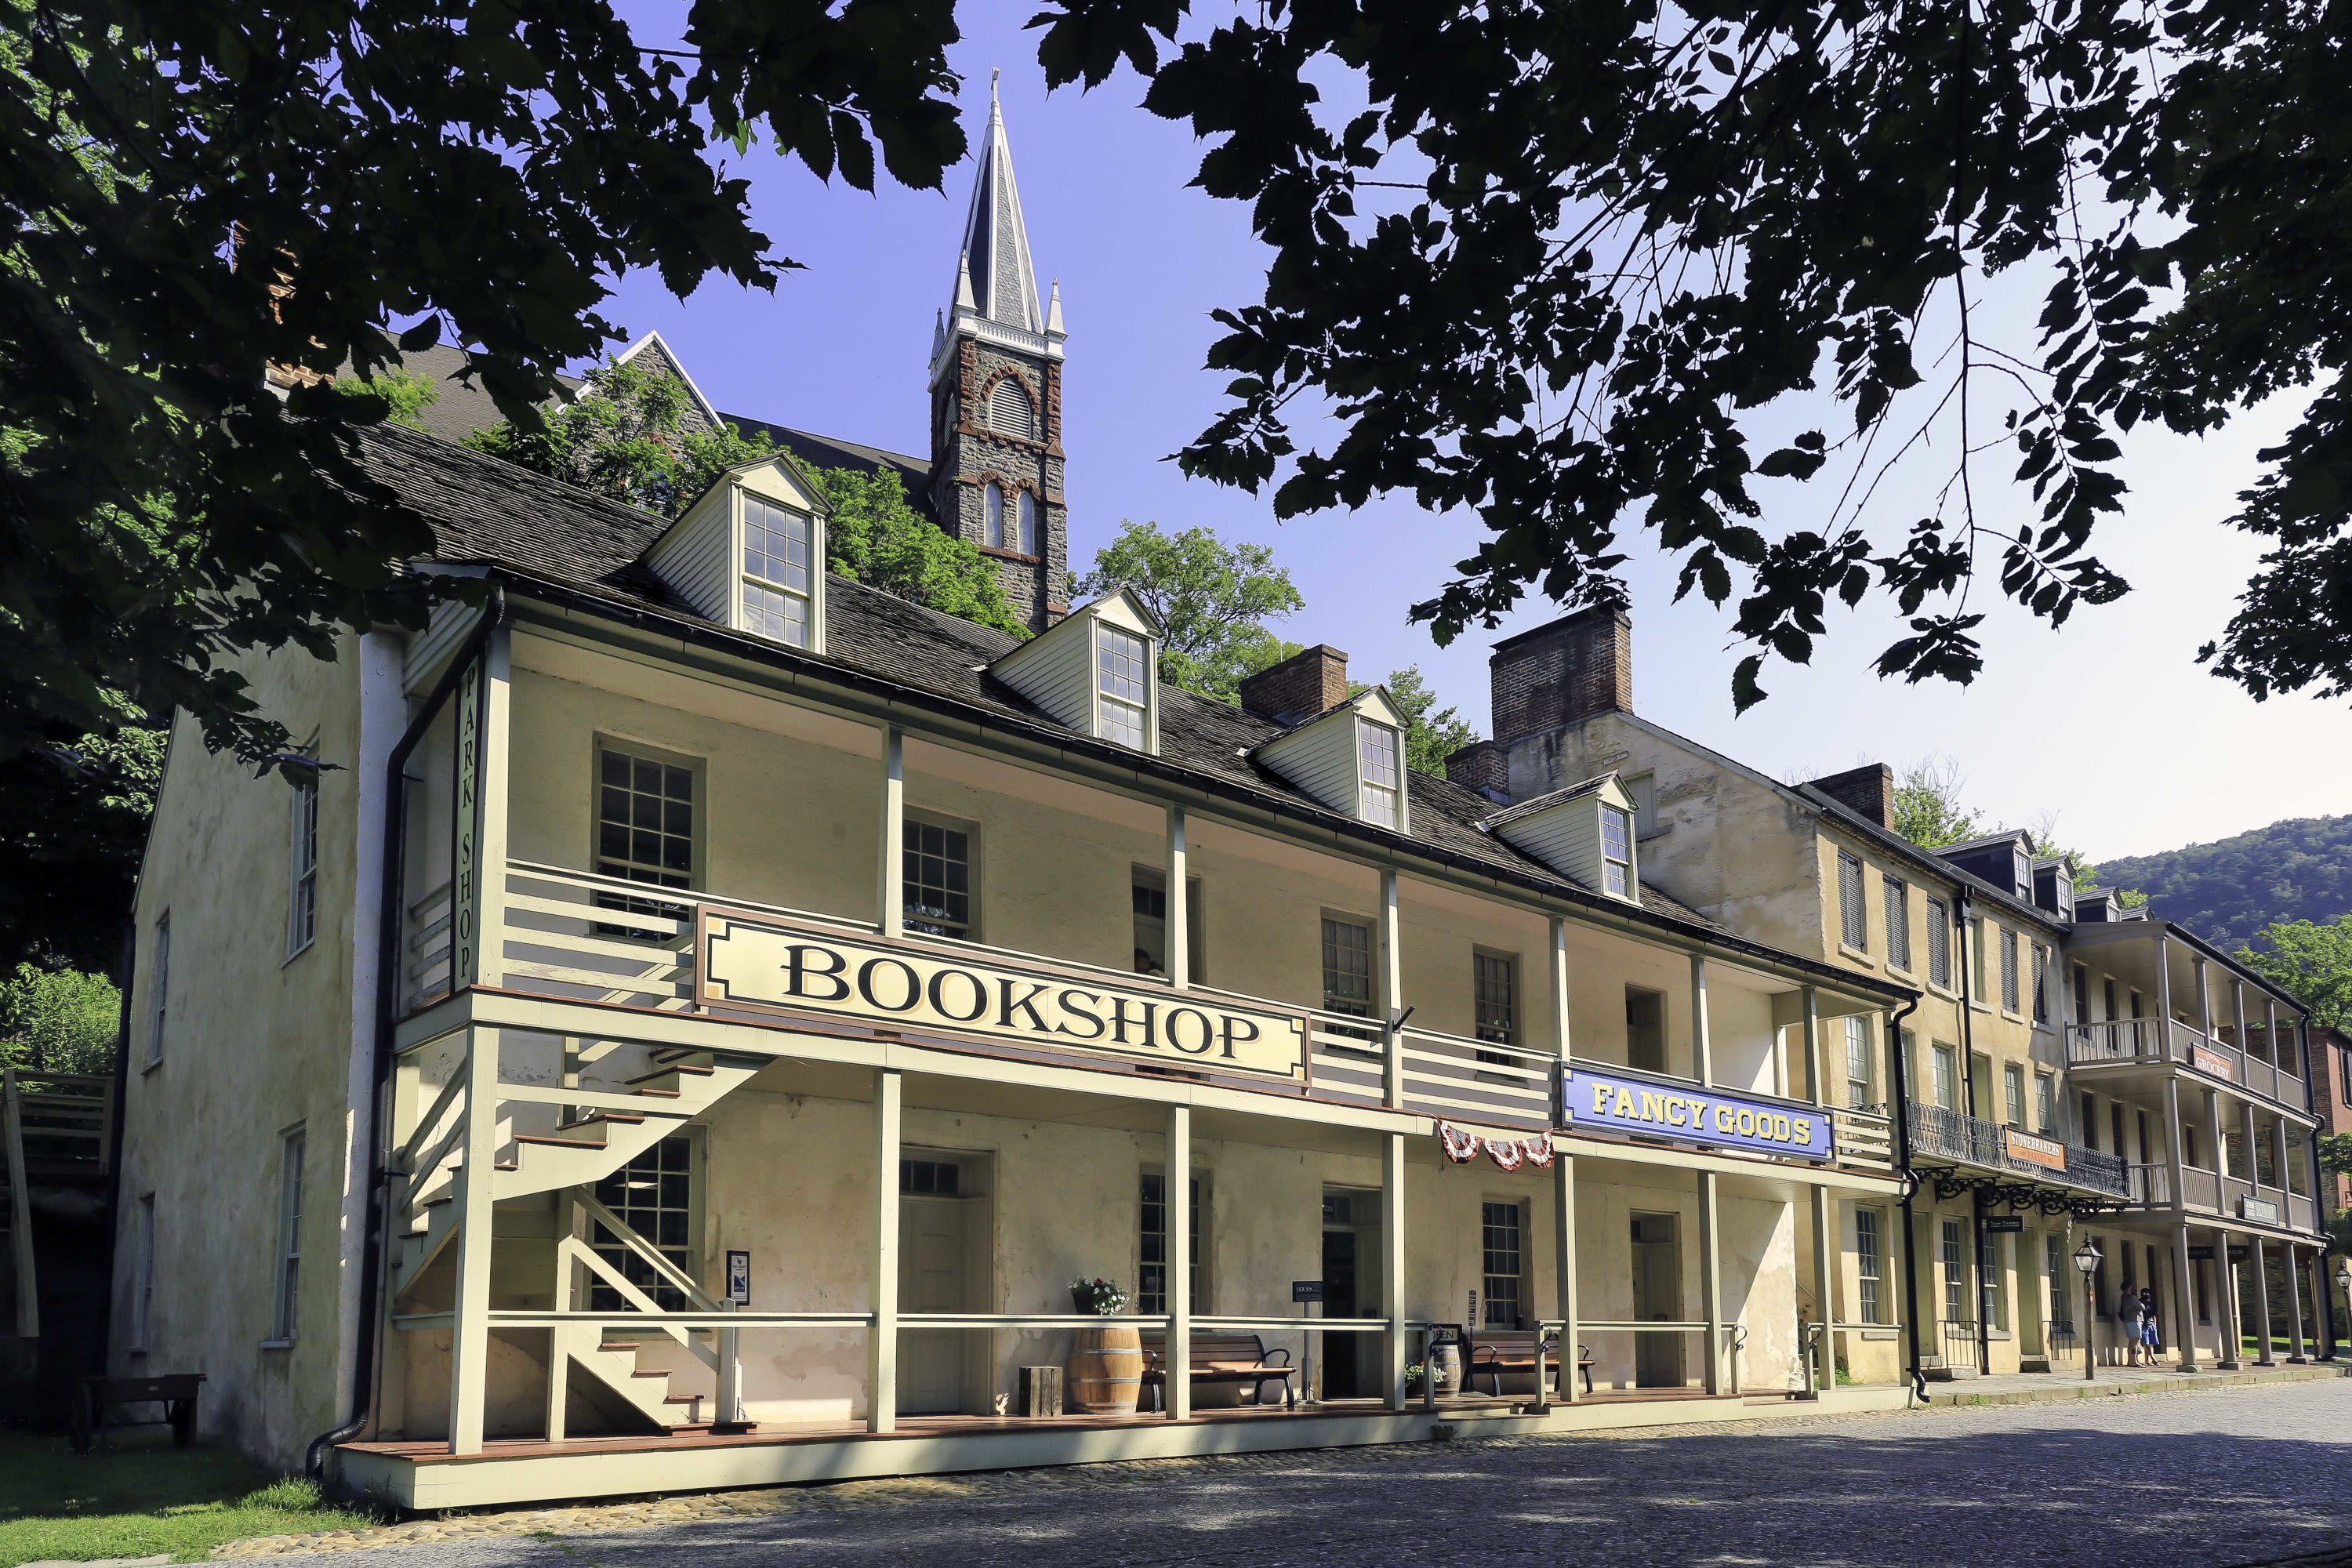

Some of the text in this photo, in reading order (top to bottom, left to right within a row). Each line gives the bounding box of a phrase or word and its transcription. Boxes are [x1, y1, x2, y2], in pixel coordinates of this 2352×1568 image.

[459, 666, 475, 978] PARK SHOP
[780, 945, 1261, 1058] BOOKSHOP
[2195, 1057, 2230, 1080] GROCERY
[1592, 1083, 1812, 1145] FANCY GOODS
[2011, 1131, 2060, 1157] STONEBRAKERS
